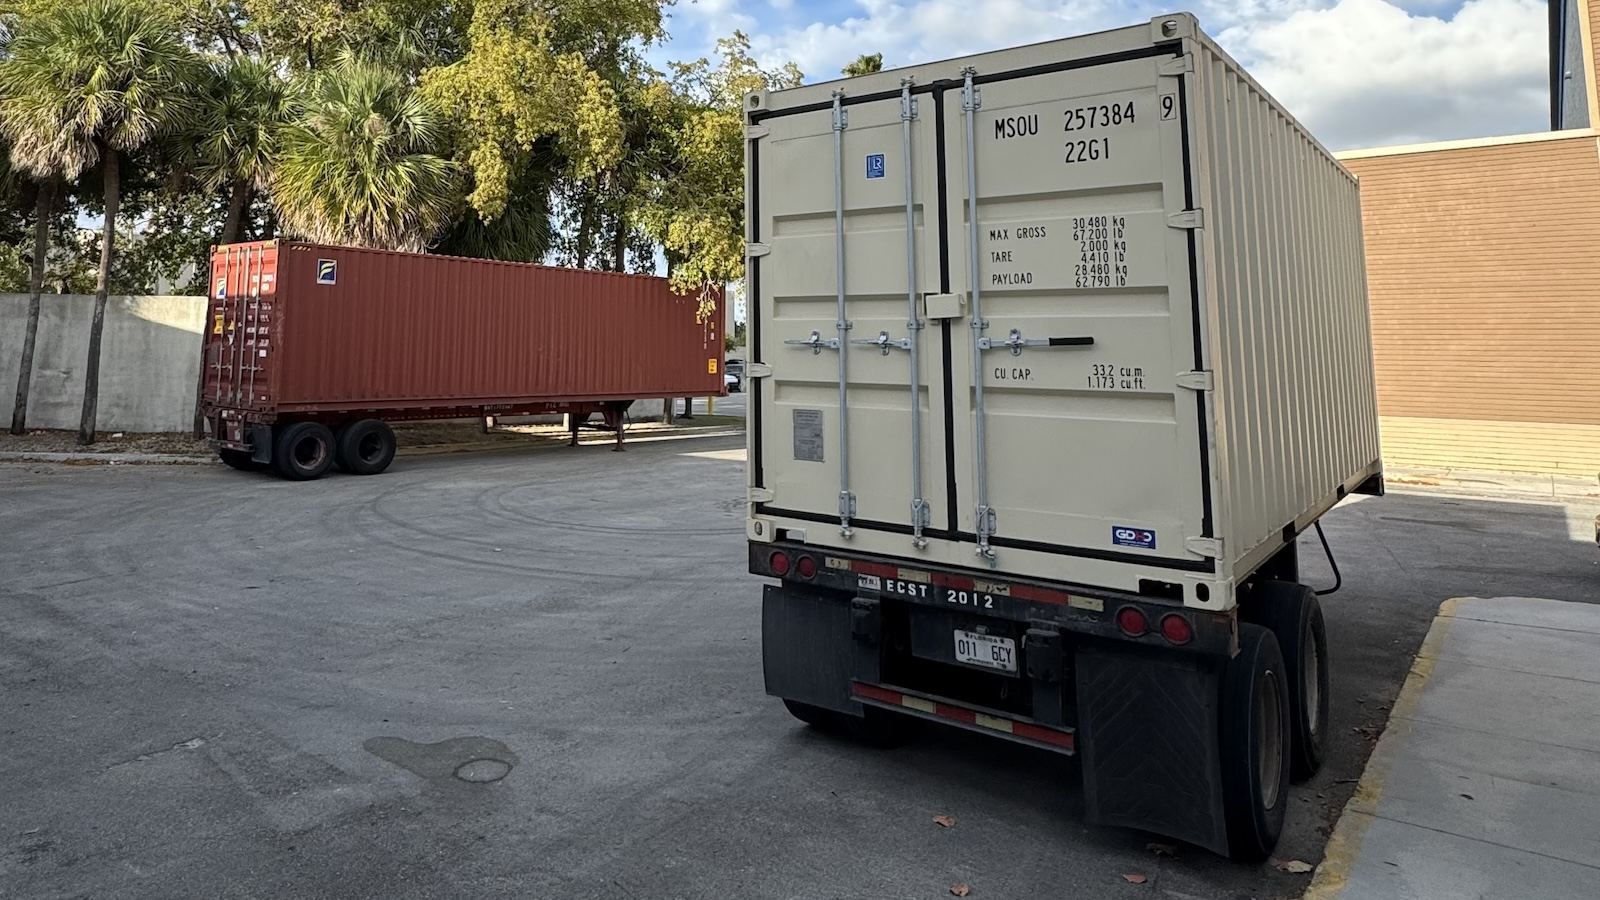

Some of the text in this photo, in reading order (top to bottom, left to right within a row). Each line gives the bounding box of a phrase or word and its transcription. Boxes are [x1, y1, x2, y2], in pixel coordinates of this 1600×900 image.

[994, 96, 1173, 140] MSOU 257384 9
[1065, 138, 1109, 163] 22G1
[1072, 215, 1125, 230] 30.480 kg
[990, 226, 1047, 241] MAX GROSS
[1073, 227, 1123, 241] 67.200 lb
[1080, 239, 1126, 253] 2.000 kg
[991, 251, 1013, 263] TARE
[1081, 251, 1124, 264] 4.410 lb
[1075, 263, 1127, 277] 28.480 kg
[992, 272, 1033, 286] PAYLOAD
[1076, 275, 1126, 288] 62.790 lb
[1088, 376, 1115, 389] 1.173
[886, 579, 928, 597] ECST
[947, 589, 993, 609] 2012
[958, 639, 977, 658] 011
[991, 645, 1012, 664] 6CY
